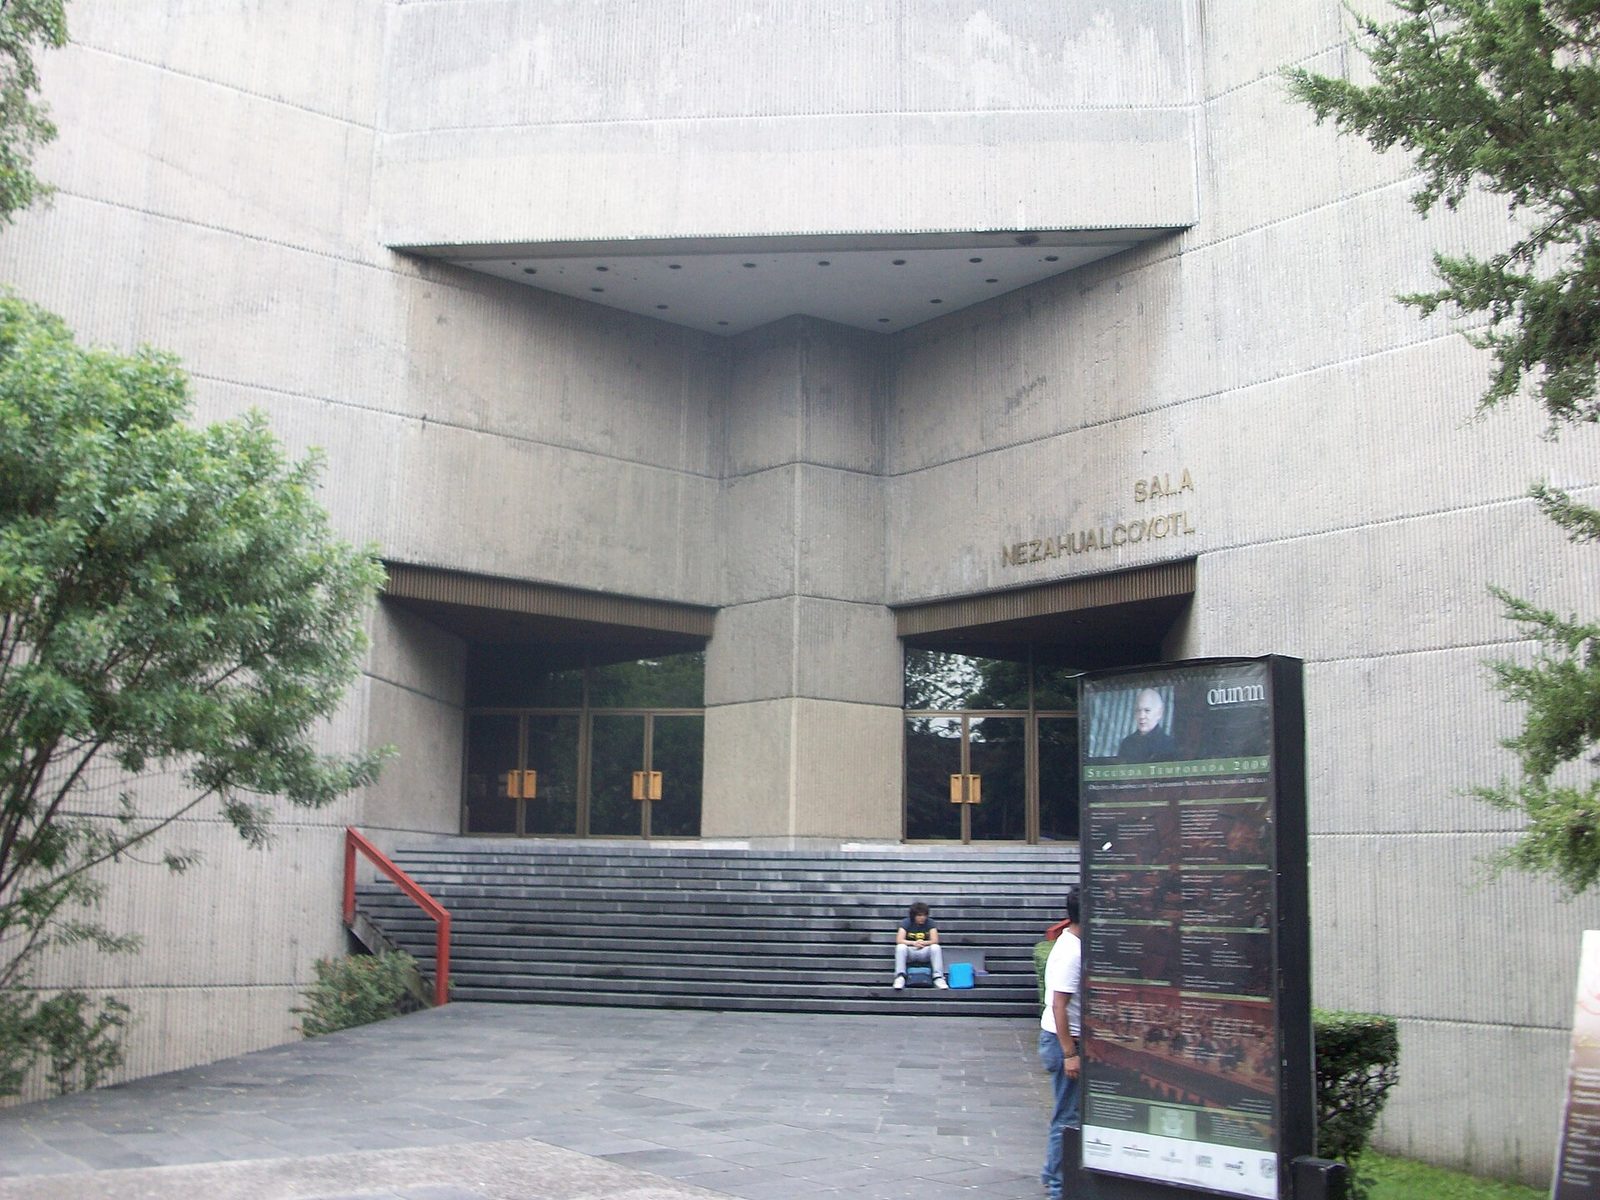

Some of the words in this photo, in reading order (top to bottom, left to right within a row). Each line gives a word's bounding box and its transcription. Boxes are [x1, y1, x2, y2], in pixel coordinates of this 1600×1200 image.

[1134, 468, 1194, 502] SALA
[1002, 511, 1195, 567] NEZAHUALCOYOTL
[1233, 759, 1269, 771] 2009
